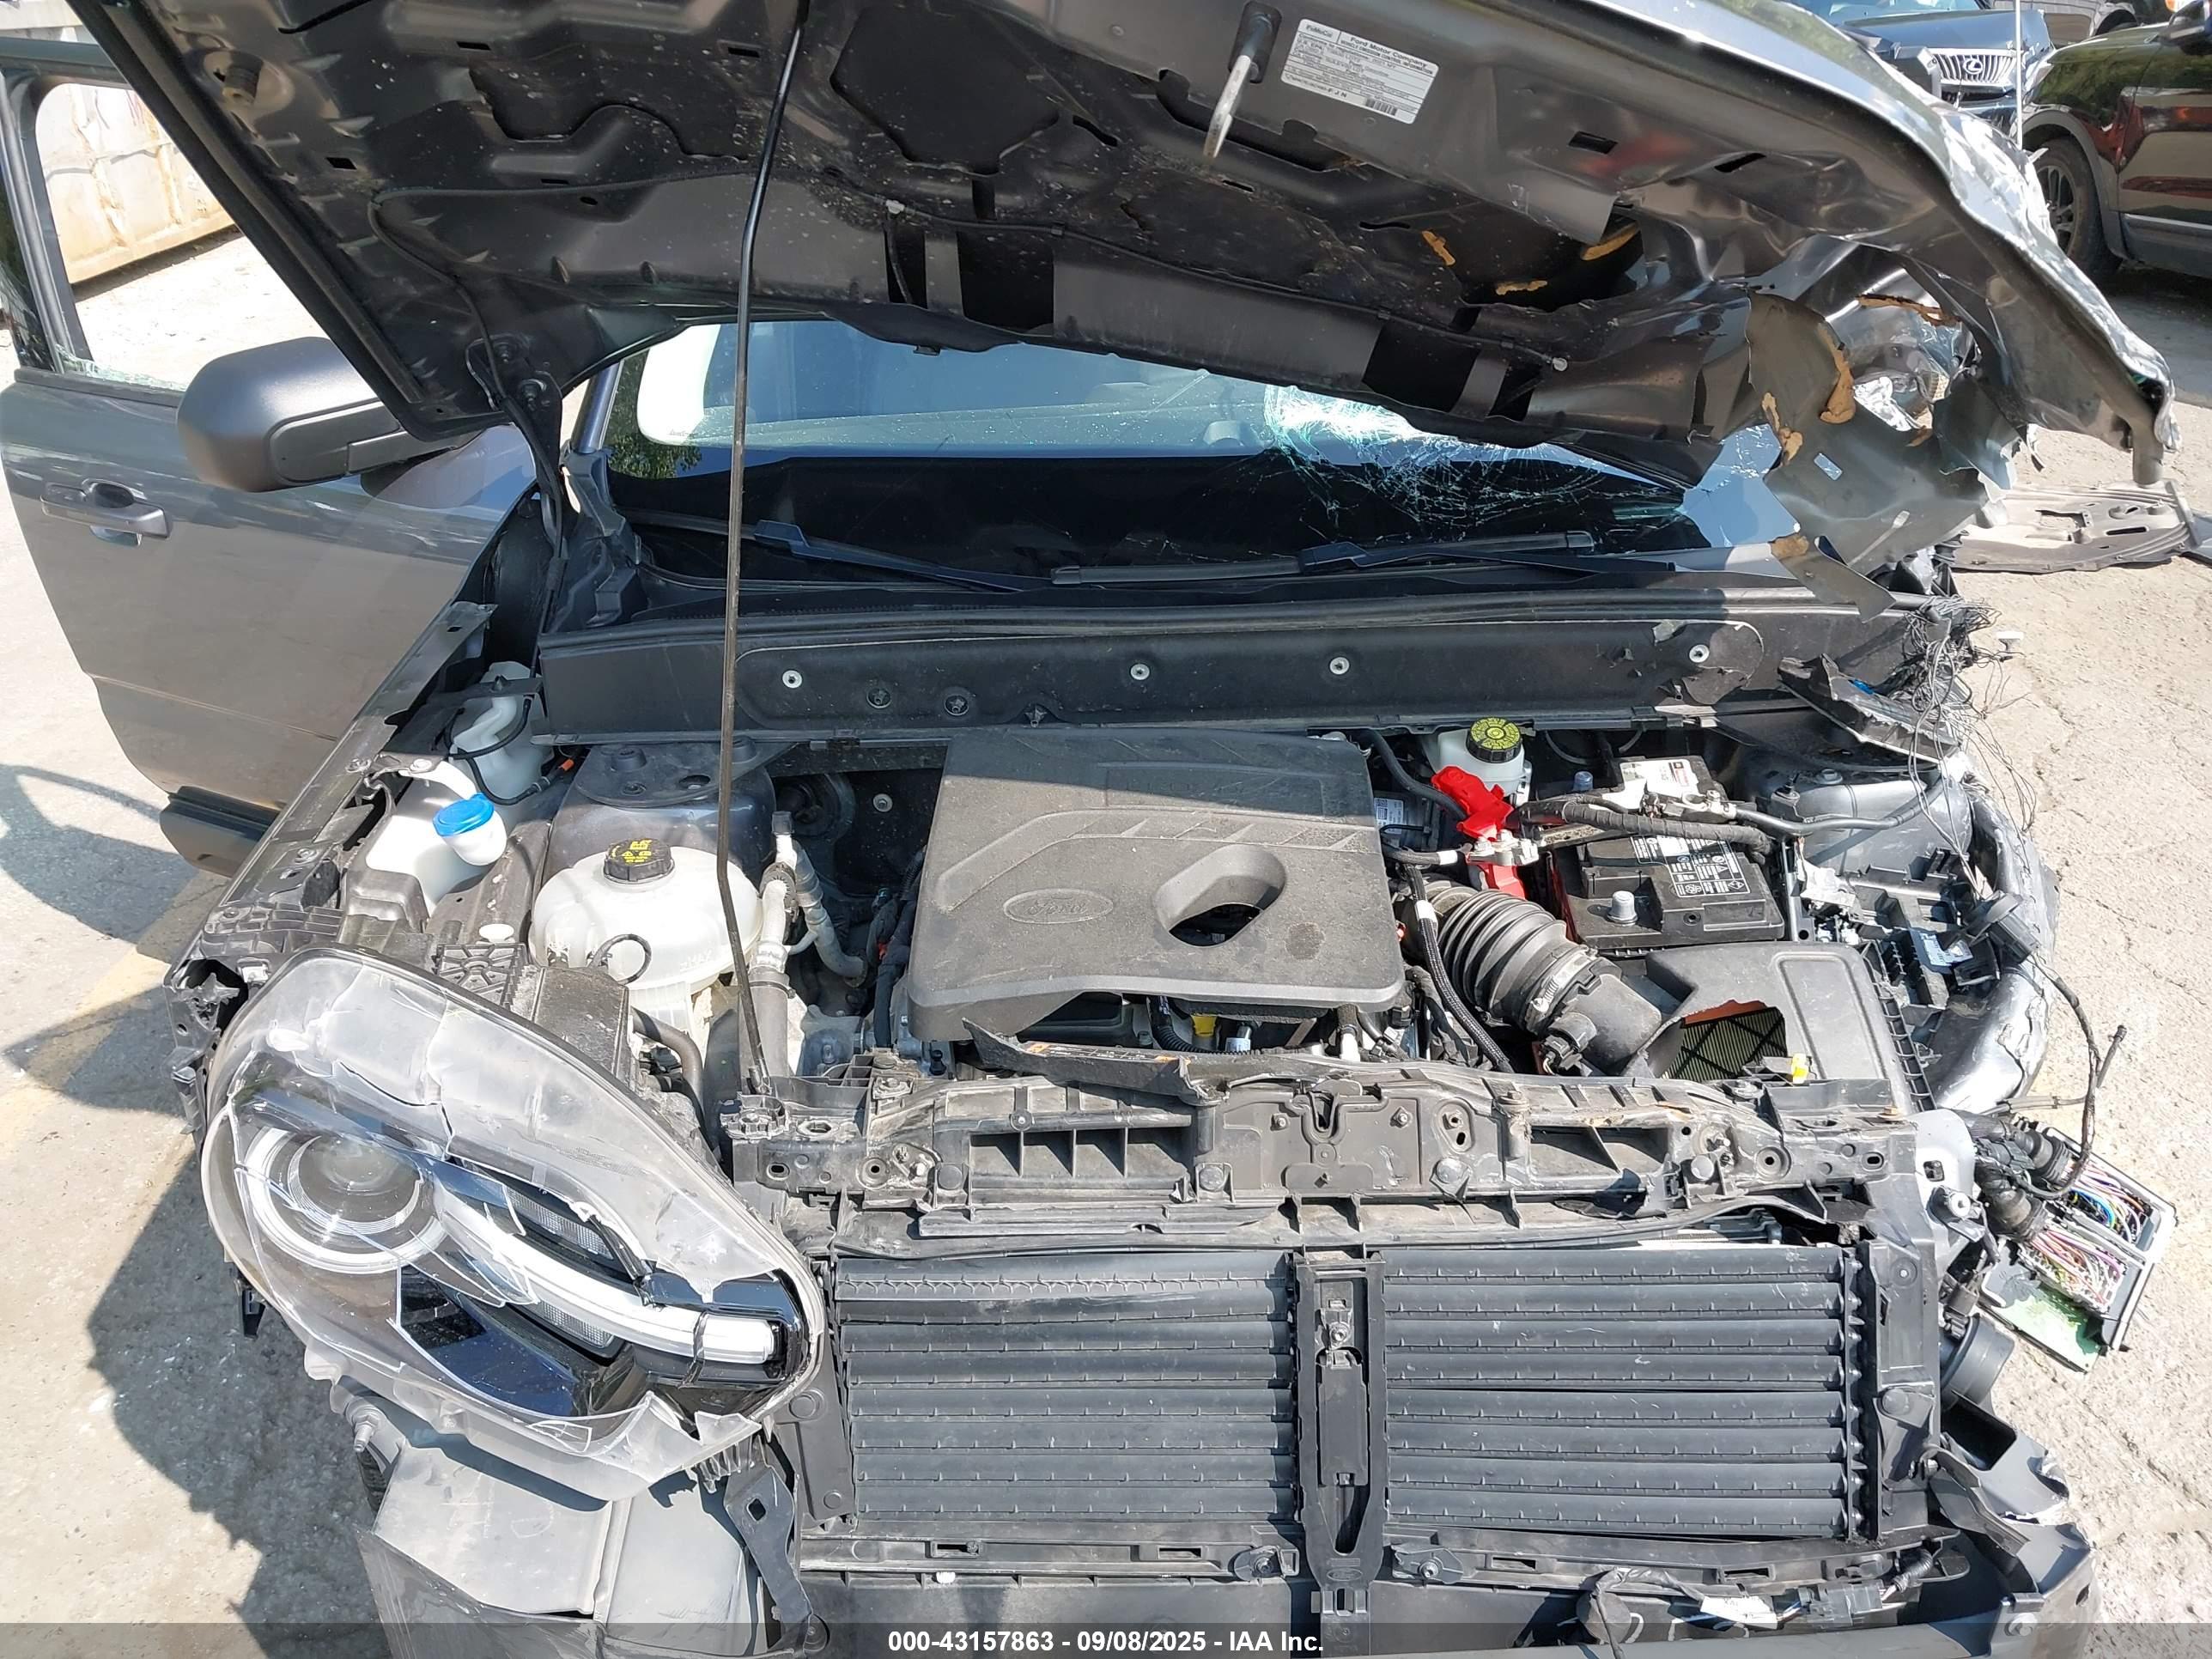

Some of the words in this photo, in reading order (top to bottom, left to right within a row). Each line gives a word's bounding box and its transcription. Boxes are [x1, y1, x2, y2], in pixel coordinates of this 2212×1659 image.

[1350, 37, 1368, 47] Ford
[1369, 43, 1391, 55] Motor
[1392, 52, 1427, 68] Company
